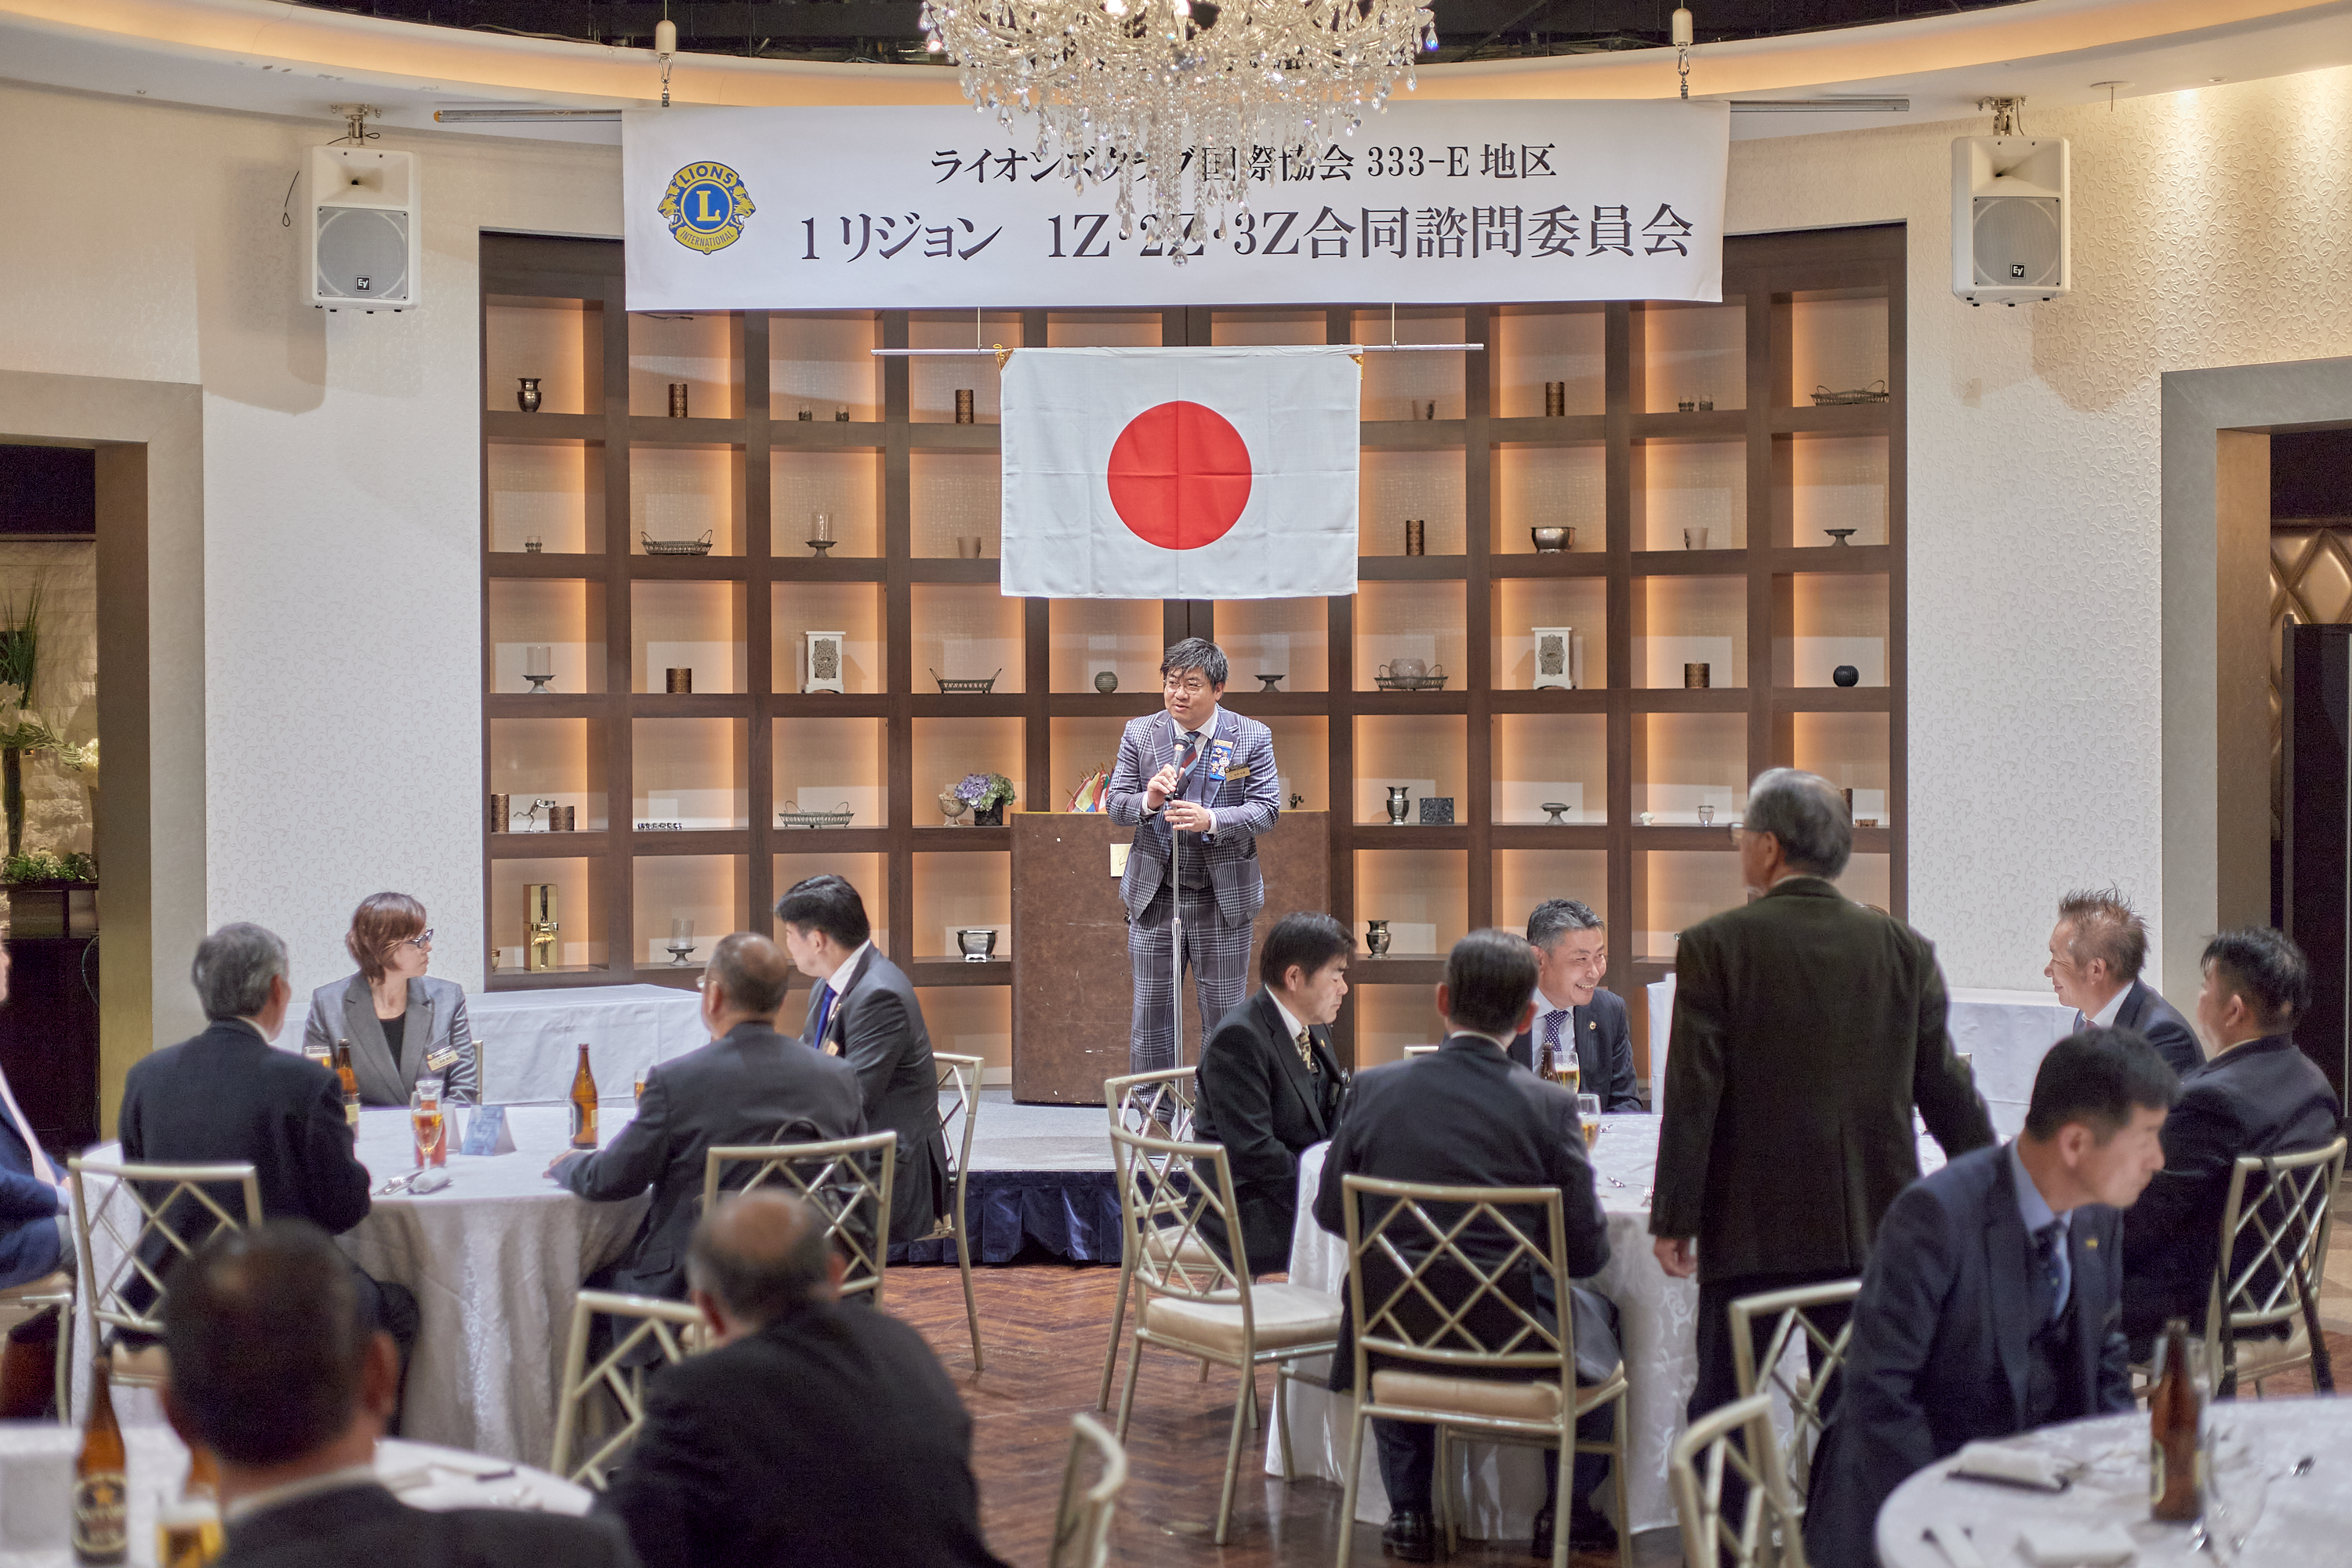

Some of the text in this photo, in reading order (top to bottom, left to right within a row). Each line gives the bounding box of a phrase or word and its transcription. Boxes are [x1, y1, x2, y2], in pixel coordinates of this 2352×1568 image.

[1367, 146, 1469, 177] 333-E
[1480, 143, 1557, 179] 地区
[679, 165, 734, 185] LIONS
[696, 191, 721, 222] L
[679, 230, 735, 247] INTERNATIONAL
